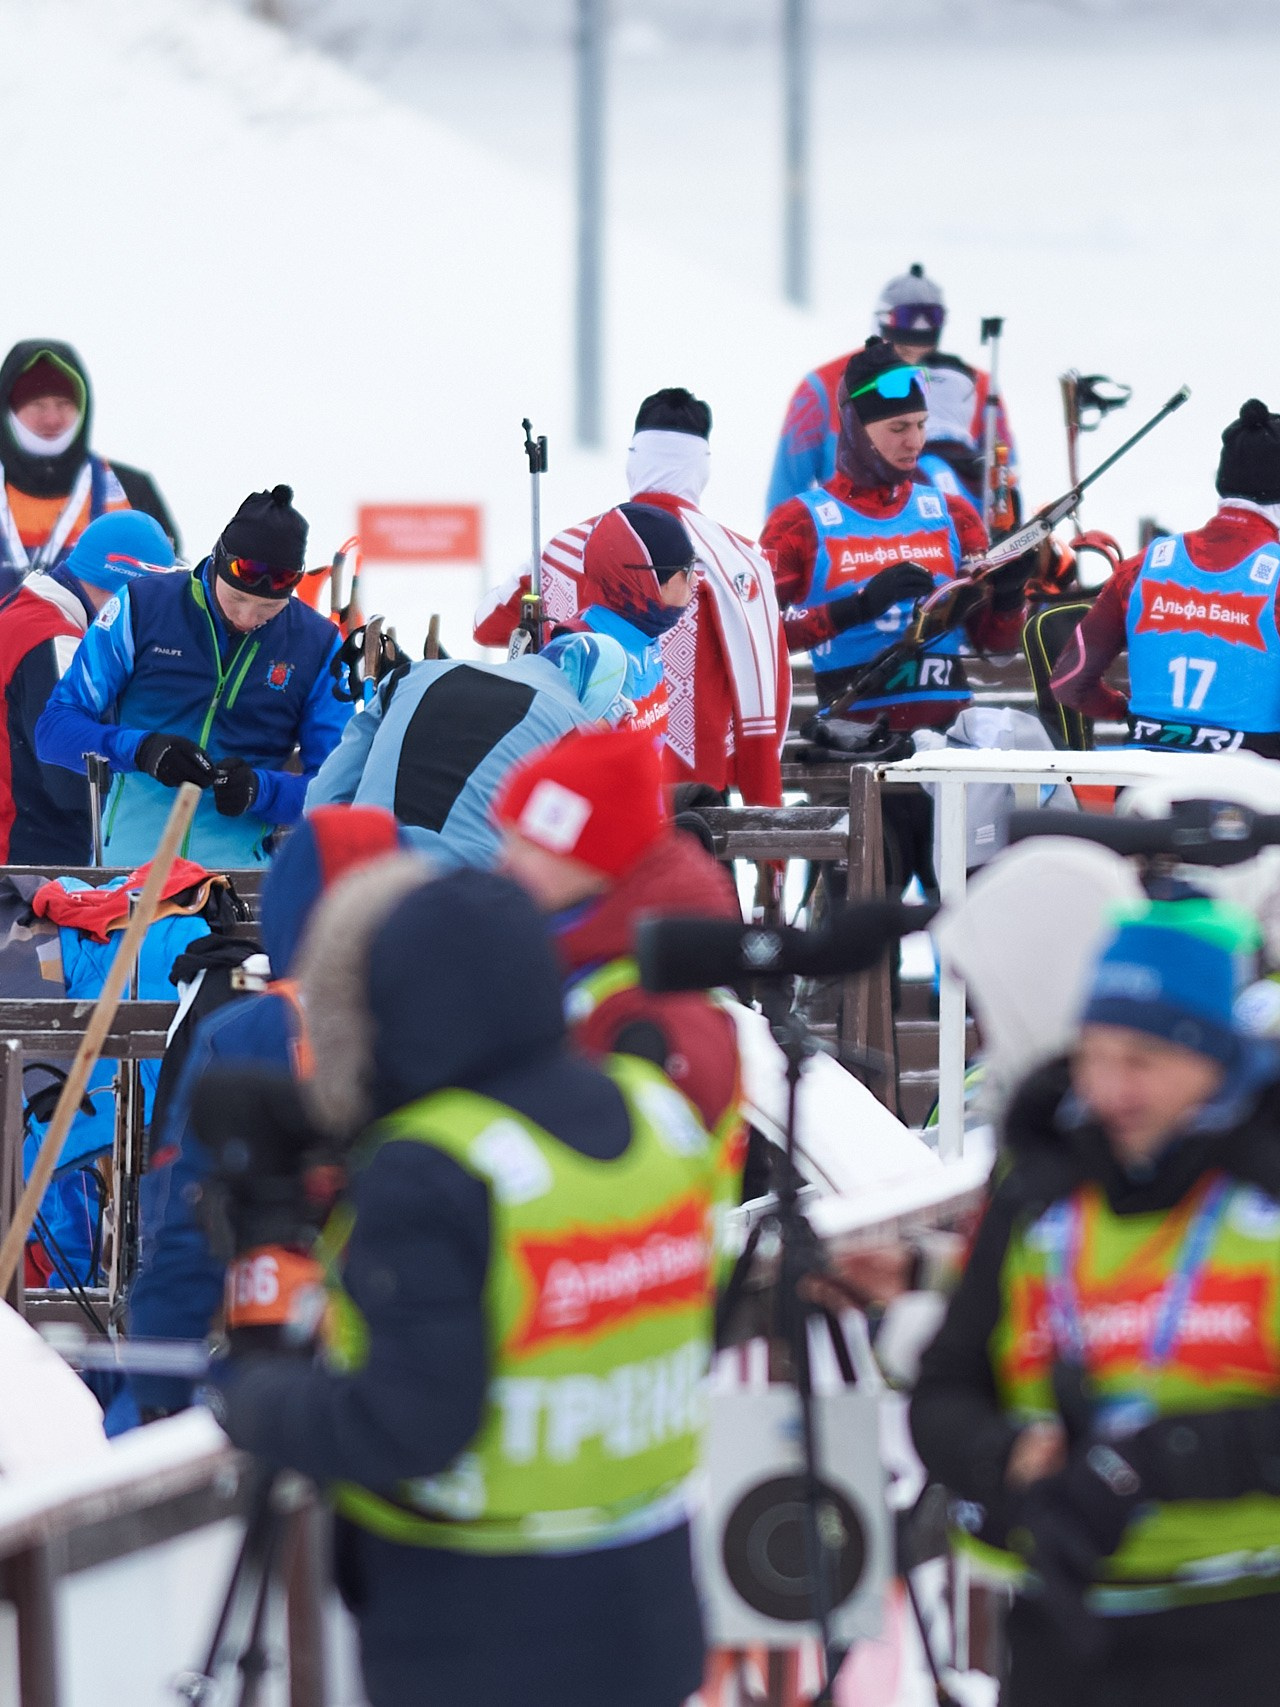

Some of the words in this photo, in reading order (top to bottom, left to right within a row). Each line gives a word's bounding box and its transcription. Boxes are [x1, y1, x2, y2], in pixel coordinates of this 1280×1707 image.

[841, 546, 898, 566] Альфа
[901, 544, 944, 560] Банк
[1151, 596, 1206, 620] Альфа
[1209, 602, 1250, 626] Банк
[1168, 656, 1217, 710] 17
